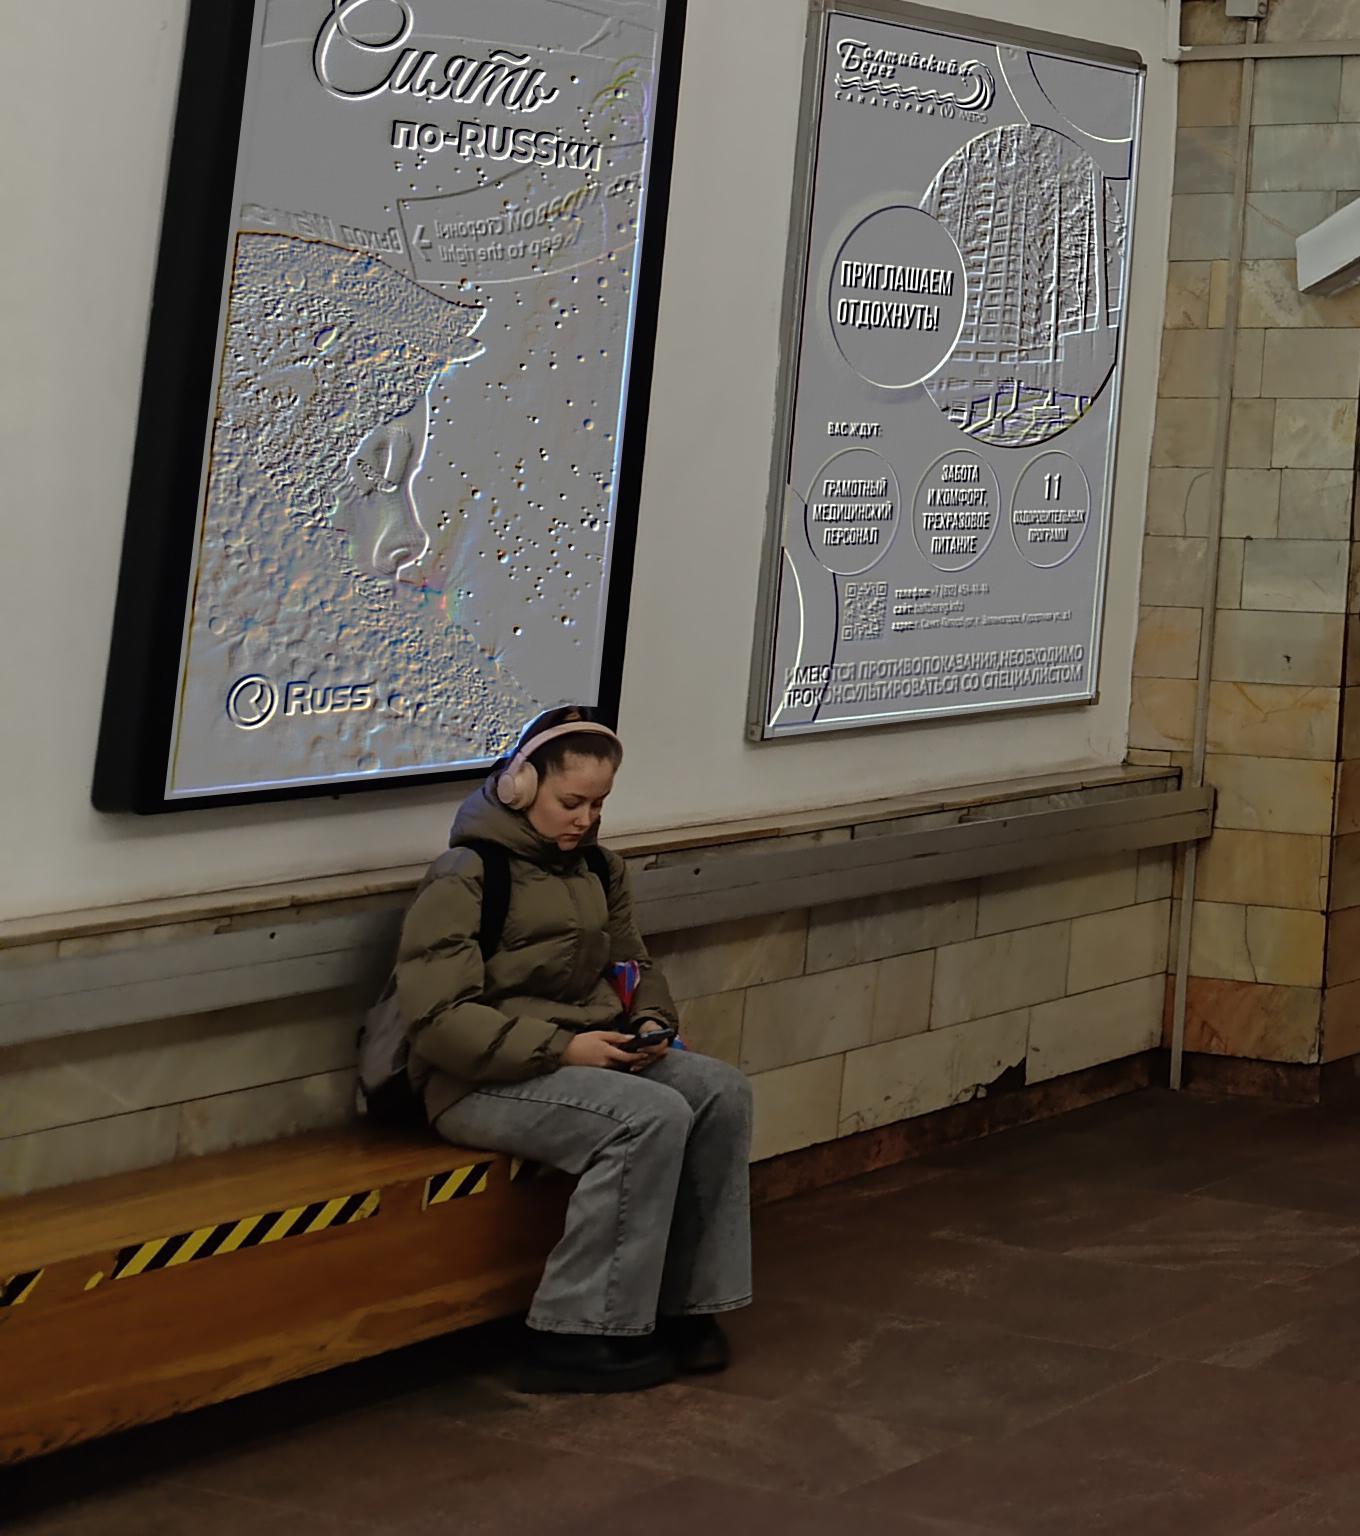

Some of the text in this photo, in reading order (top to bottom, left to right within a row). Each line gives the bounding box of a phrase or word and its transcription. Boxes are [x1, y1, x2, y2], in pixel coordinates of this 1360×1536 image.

[837, 38, 959, 76] Балтийский
[835, 91, 935, 115] САНАТОРИЙ
[840, 260, 954, 297] ПРИГЛАШАЕМ
[837, 298, 939, 332] ОТДОХНУТЬ!
[828, 422, 883, 439] ВАС ЖДУТ:
[941, 464, 980, 483] ЗАБОТА
[822, 477, 888, 499] ГРАМОТНЫЙ
[927, 488, 989, 508] И КОМФОРТ,
[1043, 473, 1062, 502] 11
[812, 501, 894, 523] МЕДИЦИНСКИЙ
[922, 511, 991, 532] ТРЕХРАЗОВОЕ
[822, 527, 879, 546] ПЕРСОНАЛ
[930, 535, 977, 555] ПИТАНИЕ
[1027, 527, 1069, 543] ПРОГРАММ
[1001, 644, 1084, 668] НЕОБХОДИМО
[782, 664, 1084, 709] ПРОКОНСУЛЬТИРОВАТЬСЯ СО СПЕЦИАЛИСТОМ
